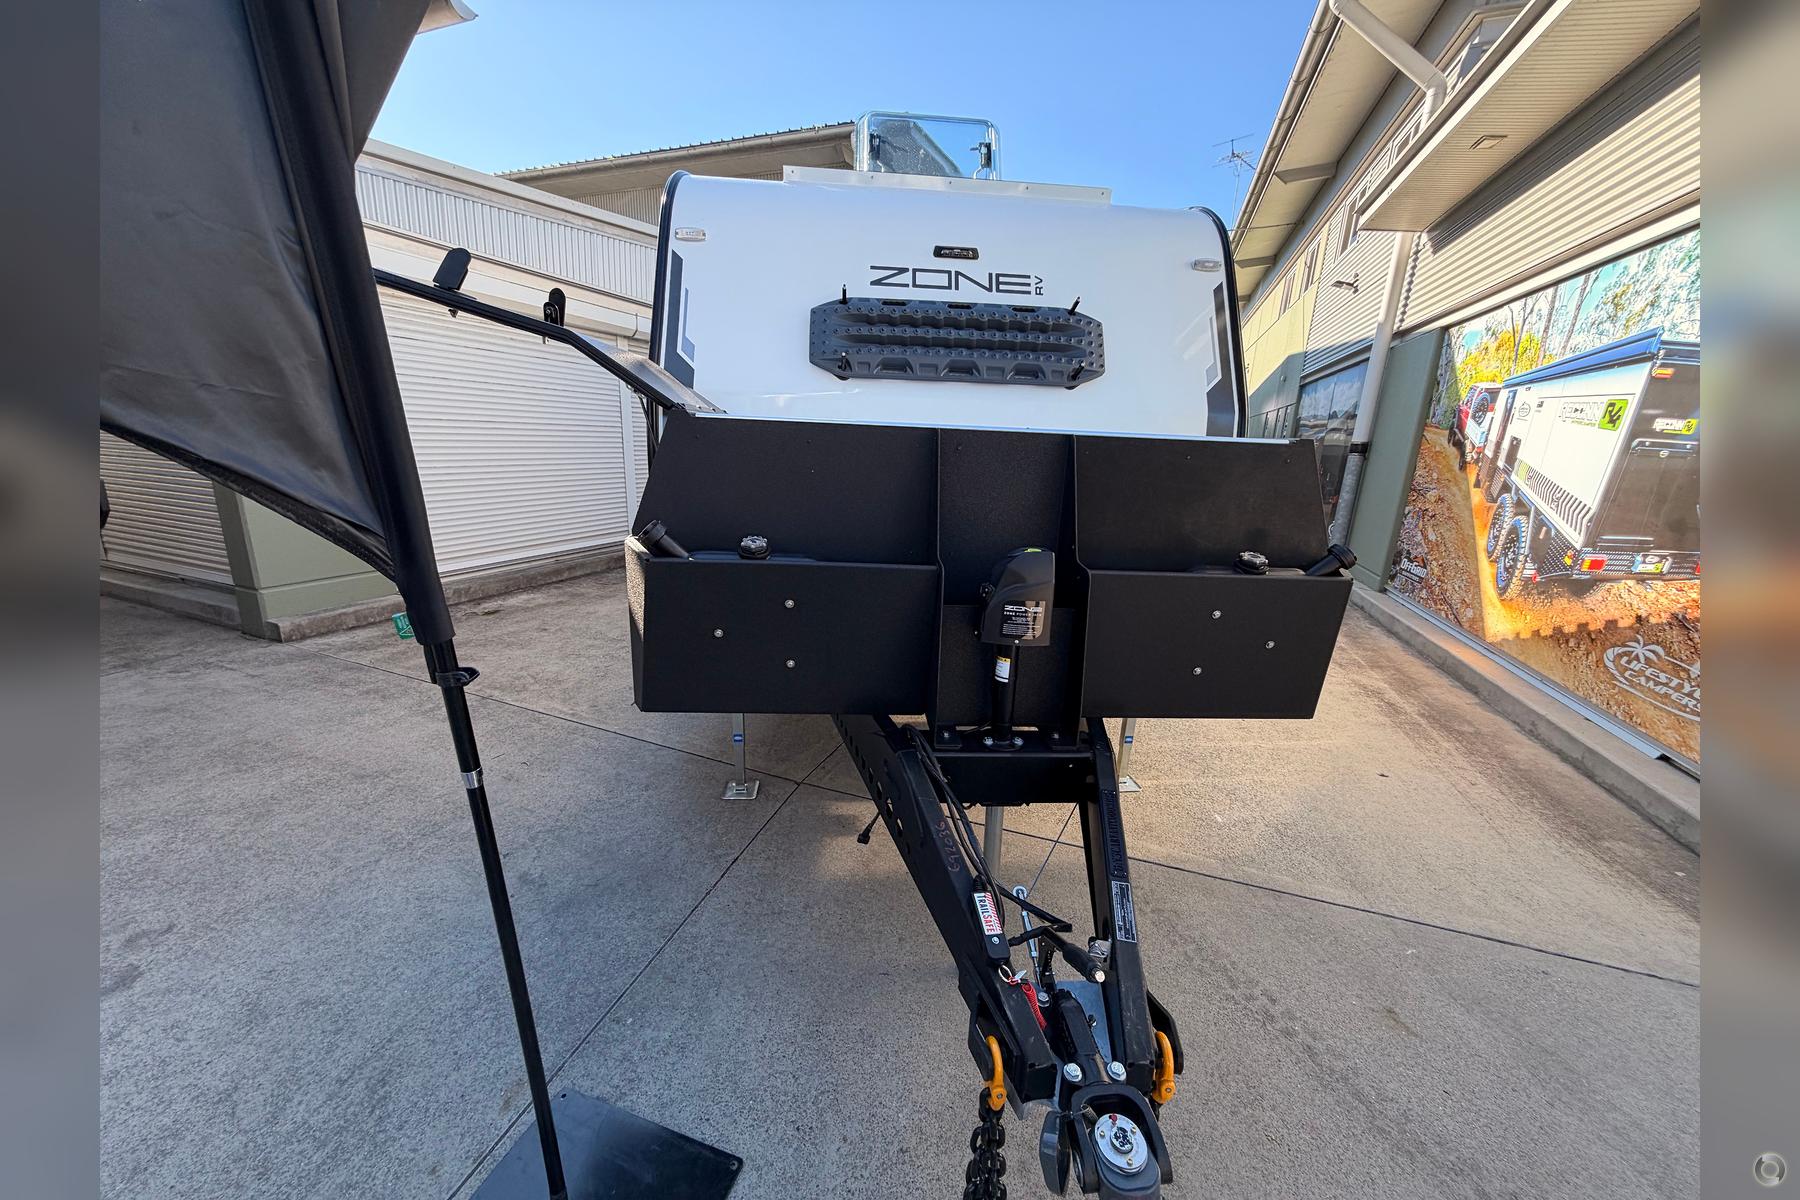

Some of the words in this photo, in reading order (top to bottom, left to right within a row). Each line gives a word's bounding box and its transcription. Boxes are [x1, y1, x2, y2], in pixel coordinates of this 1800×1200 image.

[869, 265, 1032, 295] ZONE
[1034, 275, 1044, 296] RV
[1004, 604, 1043, 613] ZONE
[976, 895, 996, 933] TRAILSAFE
